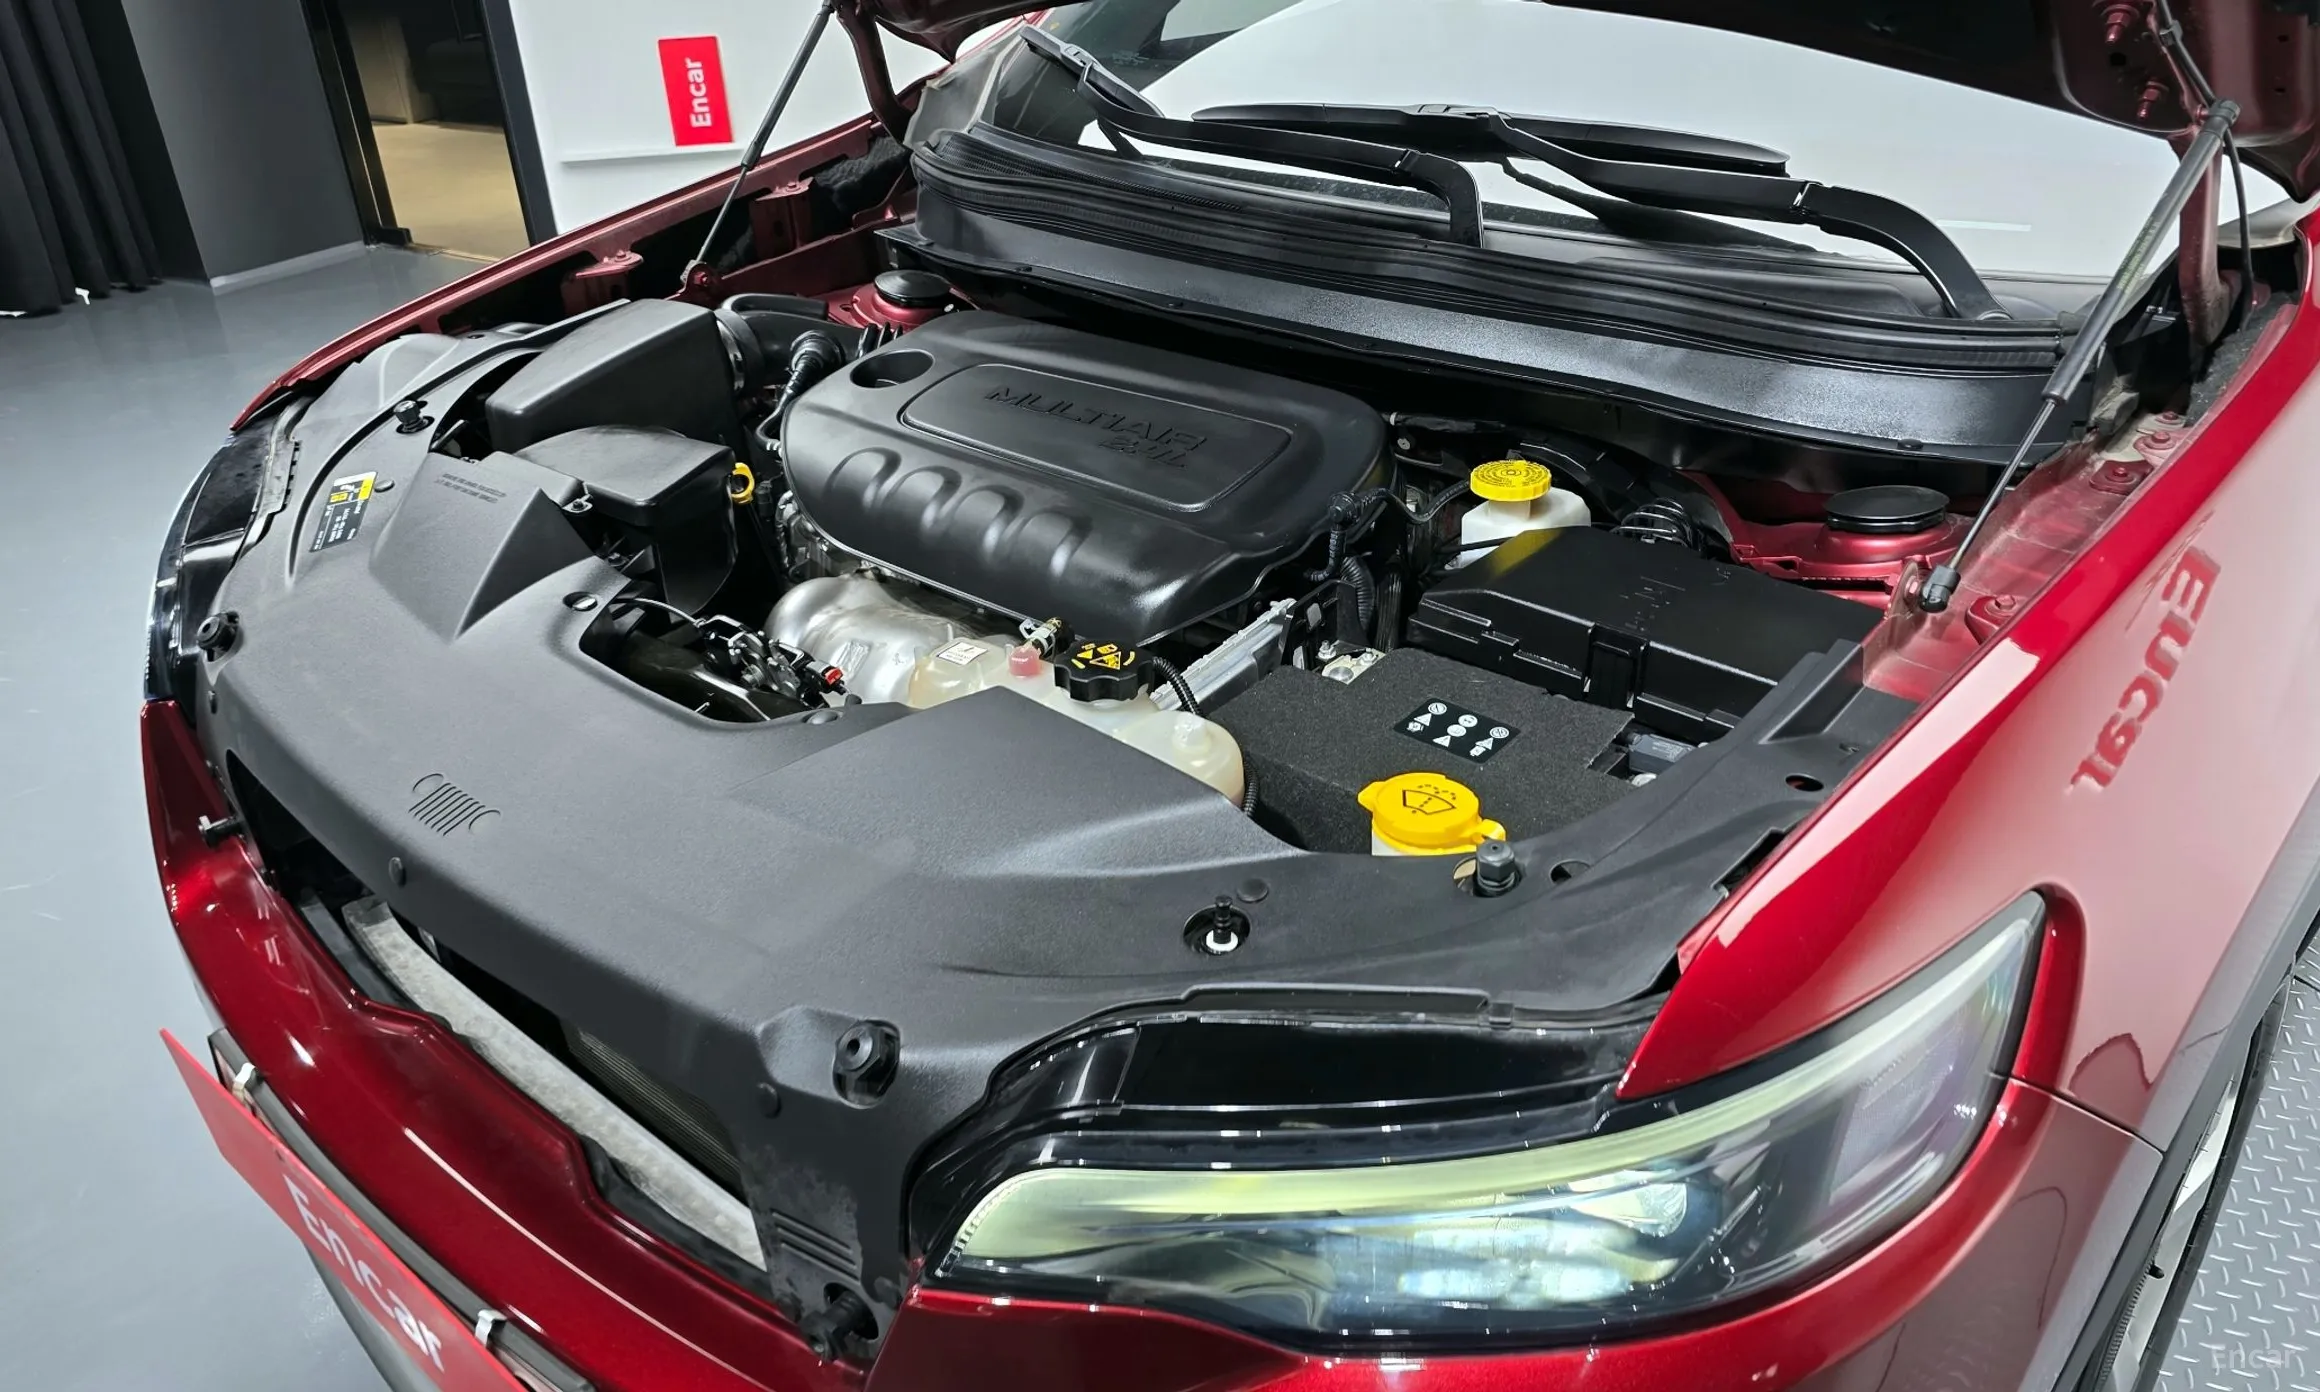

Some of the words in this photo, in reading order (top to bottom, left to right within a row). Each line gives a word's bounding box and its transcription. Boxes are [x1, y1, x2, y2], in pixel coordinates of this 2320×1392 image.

[684, 57, 713, 128] Encar
[984, 386, 1209, 453] MULTIAIR
[284, 1174, 445, 1373] Encar
